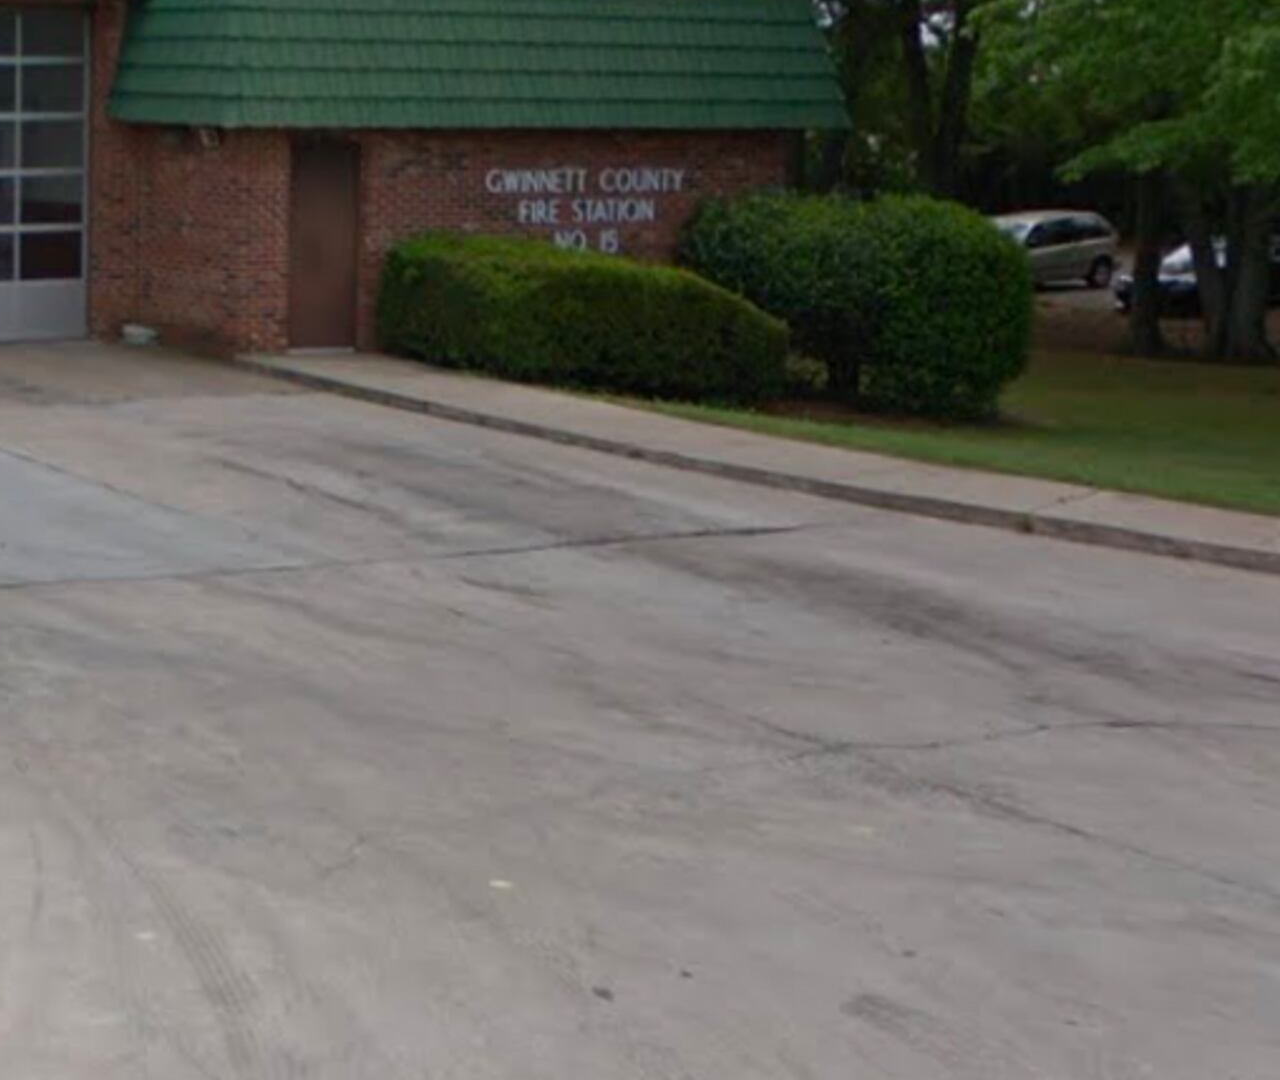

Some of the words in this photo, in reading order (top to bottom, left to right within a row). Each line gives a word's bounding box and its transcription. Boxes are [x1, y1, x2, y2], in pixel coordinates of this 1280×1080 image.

[485, 167, 587, 193] GWINNETT
[599, 167, 685, 192] COUNTY
[518, 199, 559, 223] FIRE
[571, 198, 655, 222] STATION
